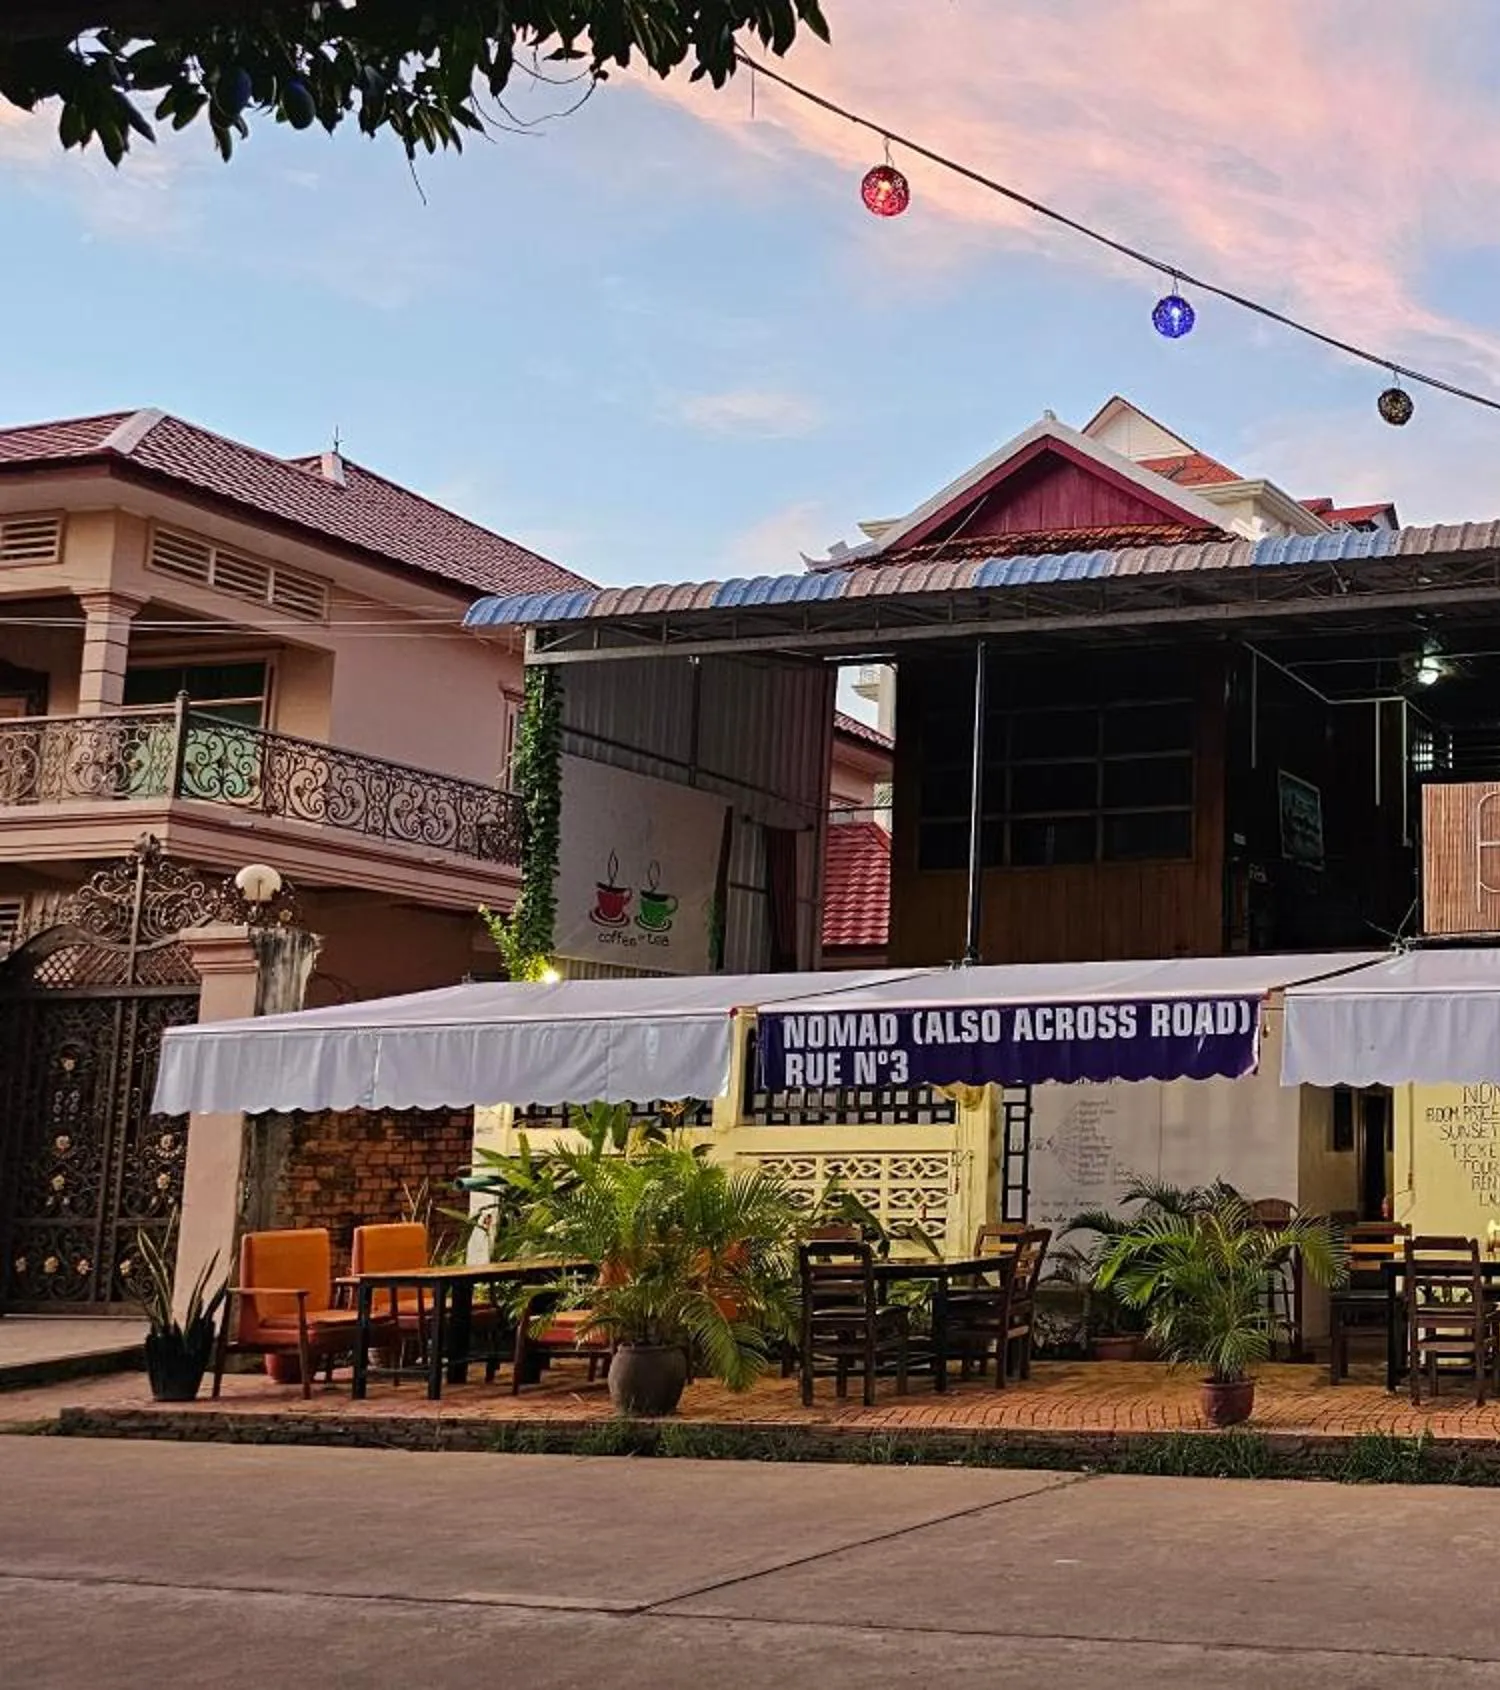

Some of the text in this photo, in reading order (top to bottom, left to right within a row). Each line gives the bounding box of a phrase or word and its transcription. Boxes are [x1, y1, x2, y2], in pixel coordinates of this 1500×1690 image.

[783, 1000, 1250, 1048] NOMAD (ALSO ACROSS ROAD)
[785, 1053, 842, 1087] RUE
[1426, 1106, 1459, 1122] ROOM
[1463, 1105, 1500, 1121] PRICE
[1439, 1122, 1500, 1141] SUNSET
[1459, 1159, 1500, 1174] TOUR
